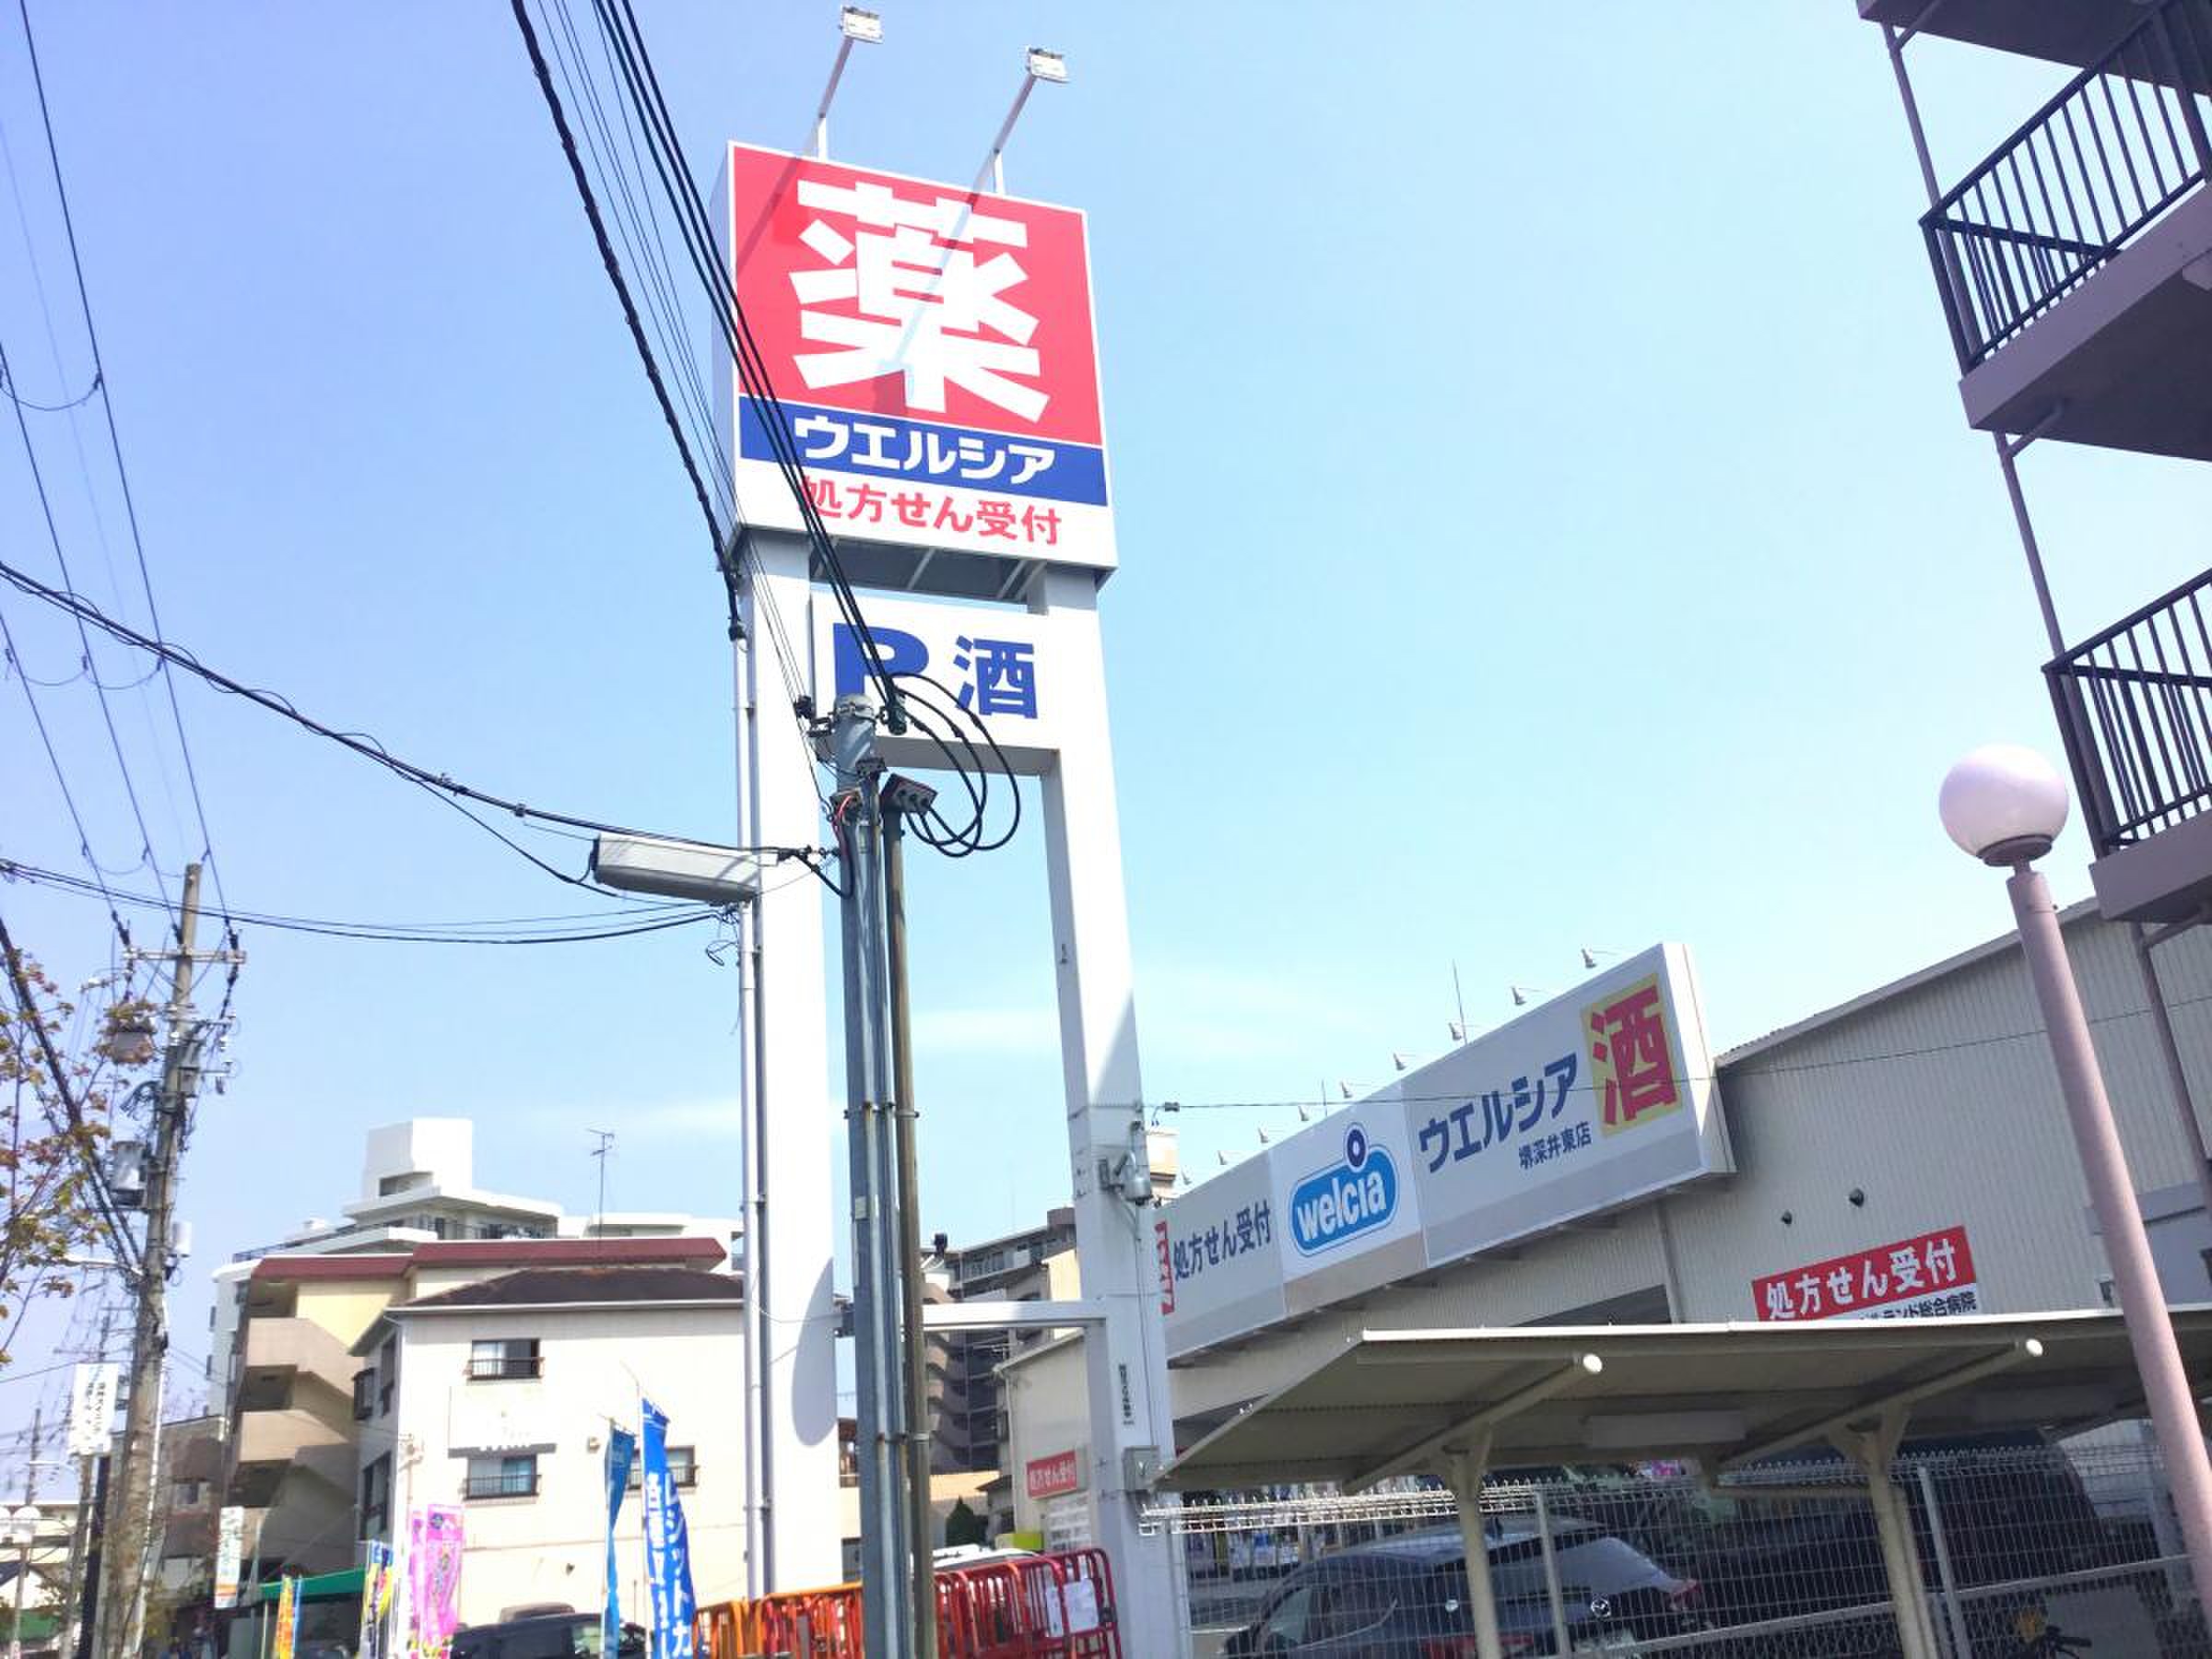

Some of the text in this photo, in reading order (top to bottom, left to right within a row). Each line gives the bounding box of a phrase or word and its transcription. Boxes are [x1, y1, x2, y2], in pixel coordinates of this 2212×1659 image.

[789, 180, 1050, 423] 薬
[794, 415, 1055, 485] ウエルシア
[799, 474, 1062, 546] 処方せん受付
[833, 623, 929, 698] P
[953, 635, 1038, 720] 酒
[1590, 984, 1678, 1126] 酒
[1419, 1053, 1579, 1173] ウエルシア
[1297, 1129, 1386, 1241] welcia
[1173, 1199, 1271, 1282] 処方せん受付
[1766, 1237, 1956, 1321] 処方せん受付
